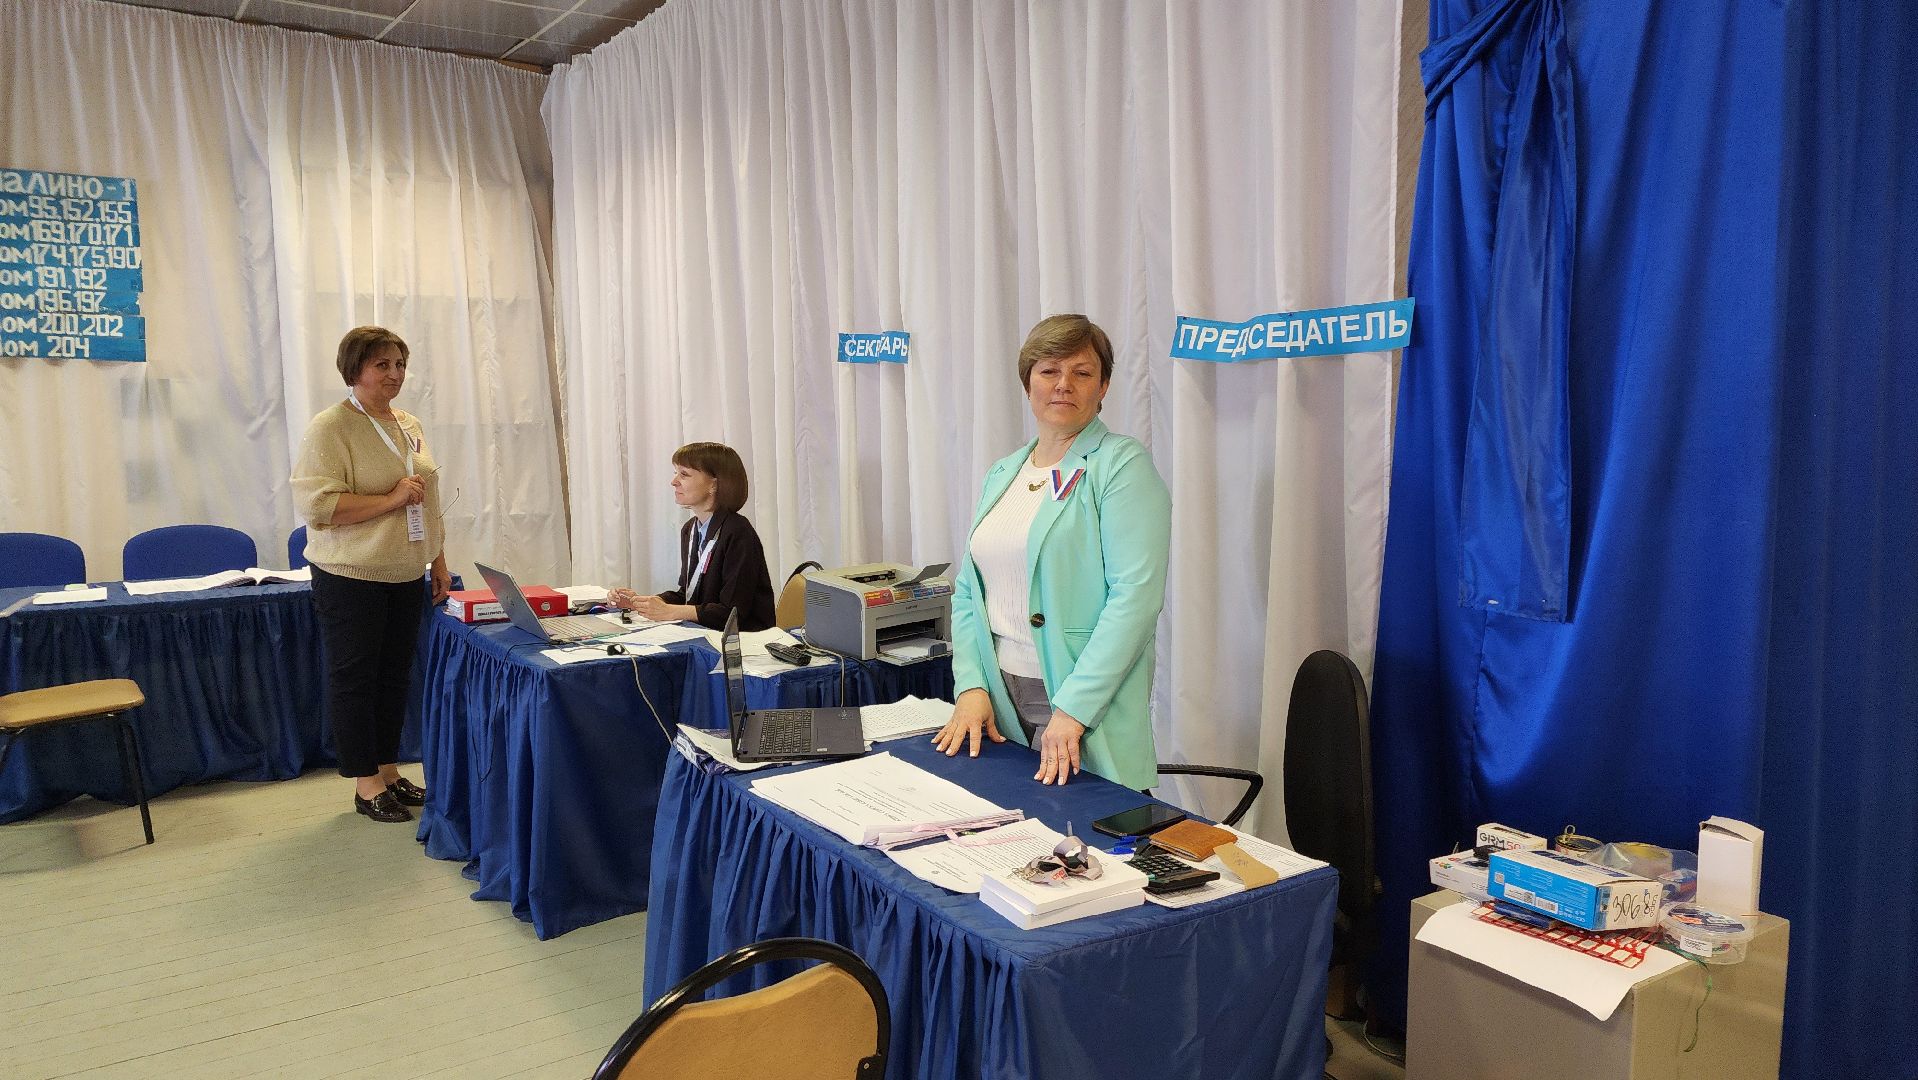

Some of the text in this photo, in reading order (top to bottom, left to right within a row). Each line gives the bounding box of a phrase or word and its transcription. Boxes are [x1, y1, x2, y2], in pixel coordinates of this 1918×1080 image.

[0, 171, 134, 201] алино-1
[47, 336, 89, 357] 204
[1178, 309, 1408, 358] ПРЕДСЕДАТЕЛЬ
